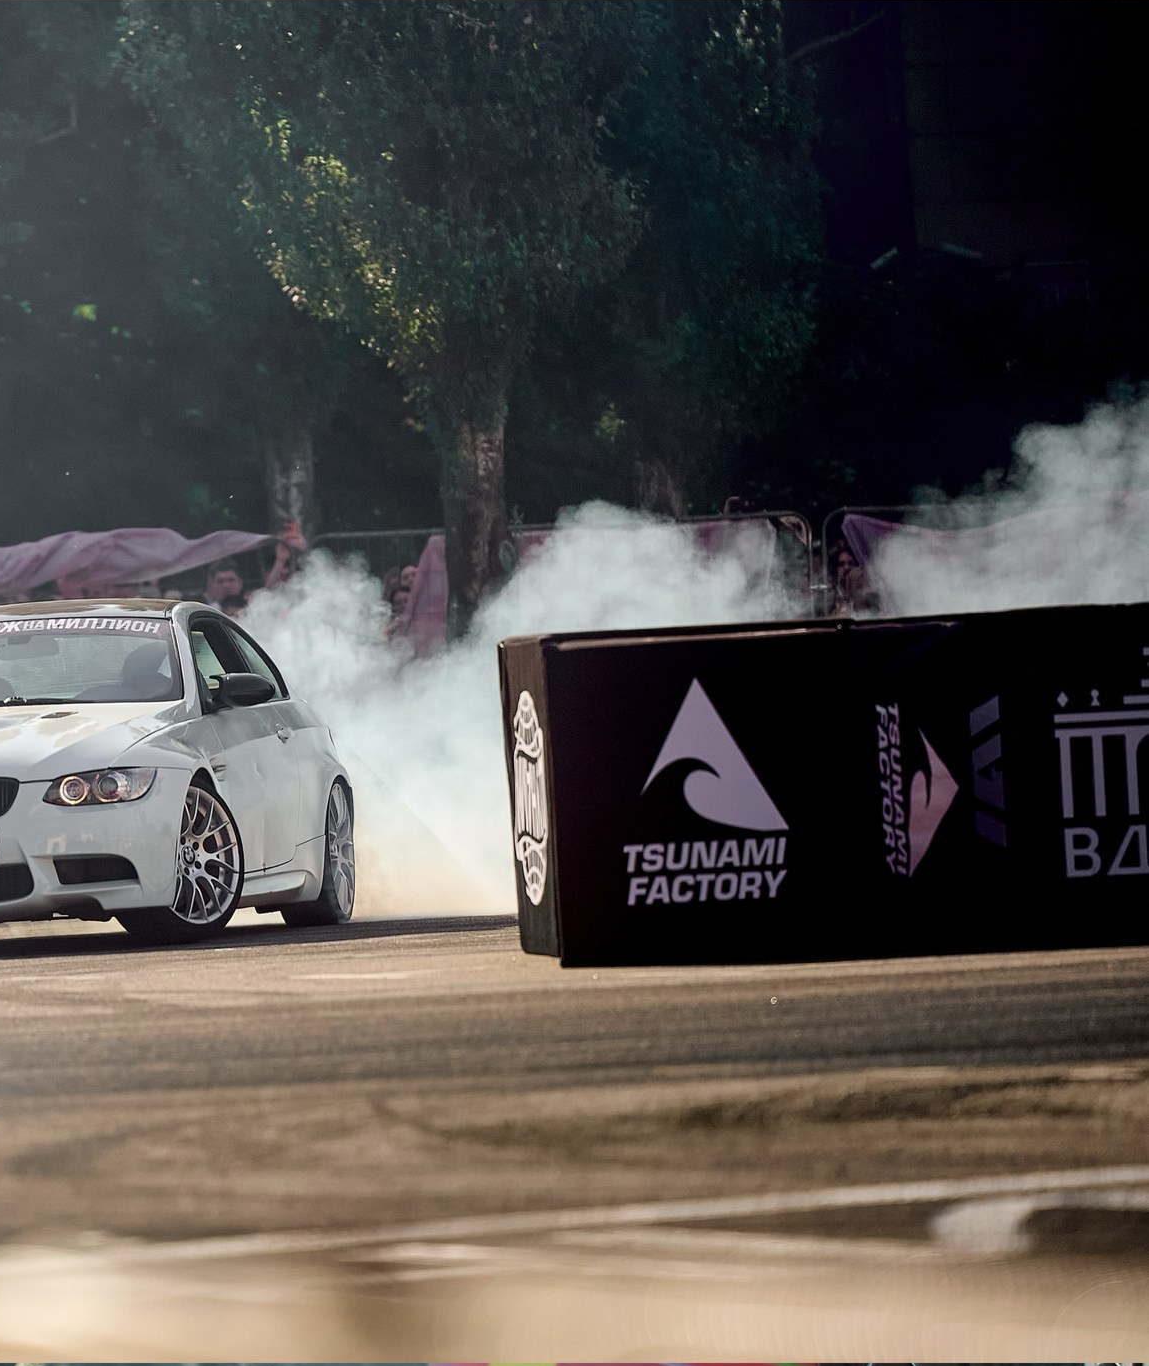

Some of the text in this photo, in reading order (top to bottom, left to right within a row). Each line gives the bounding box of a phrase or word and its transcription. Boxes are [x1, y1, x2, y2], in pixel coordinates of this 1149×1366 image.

[46, 618, 161, 634] МИЛЛИОН
[875, 703, 897, 875] FACTORY
[887, 702, 907, 876] TSUNAMI
[623, 837, 787, 874] TSUNAMI
[627, 869, 788, 906] FACTORY
